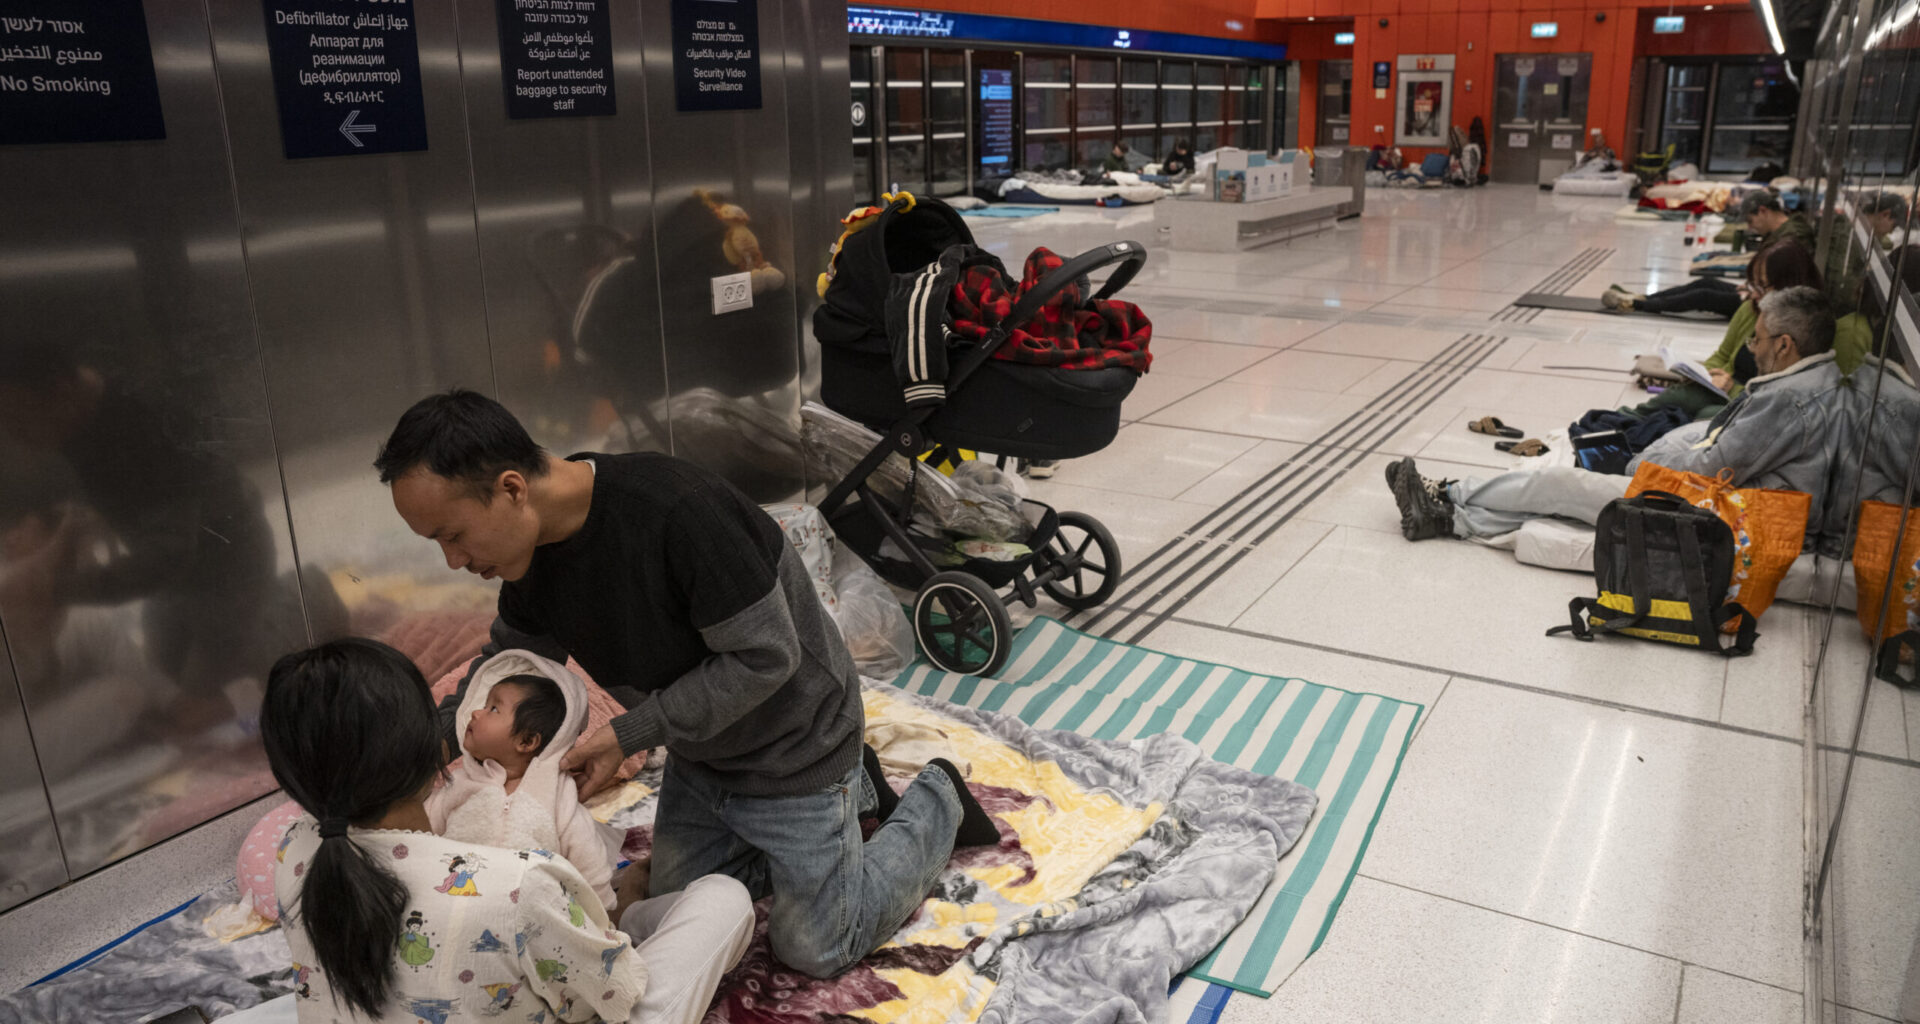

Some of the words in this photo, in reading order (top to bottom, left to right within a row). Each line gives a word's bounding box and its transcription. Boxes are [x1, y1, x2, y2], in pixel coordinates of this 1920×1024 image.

[515, 0, 548, 10] הביטחון
[551, 0, 573, 9] לצוות
[575, 2, 595, 11] דווחו
[276, 11, 350, 25] Defibrillator
[353, 13, 384, 30] إنعاش
[388, 14, 408, 30] جهاز
[525, 13, 548, 22] עזובה
[551, 14, 575, 23] כבודה
[577, 14, 588, 24] על
[1, 17, 43, 33] לעשן
[46, 20, 84, 33] אסור
[310, 34, 359, 50] Аппарат
[363, 38, 384, 49] для
[543, 33, 574, 46] موظفي
[56, 48, 102, 65] ممنوع
[529, 48, 555, 60] متروكة
[580, 49, 590, 61] عن
[313, 55, 385, 68] реанимации
[300, 68, 400, 85] (дефибриллятор)
[518, 69, 550, 82] Report
[552, 68, 603, 79] unattended
[694, 67, 724, 79] Security
[726, 68, 746, 77] Video
[0, 76, 27, 91] No
[32, 76, 110, 95] Smoking
[516, 85, 557, 98] baggage
[559, 85, 569, 94] to
[571, 84, 607, 96] security
[699, 81, 743, 91] Surveillance
[554, 99, 574, 110] staff
